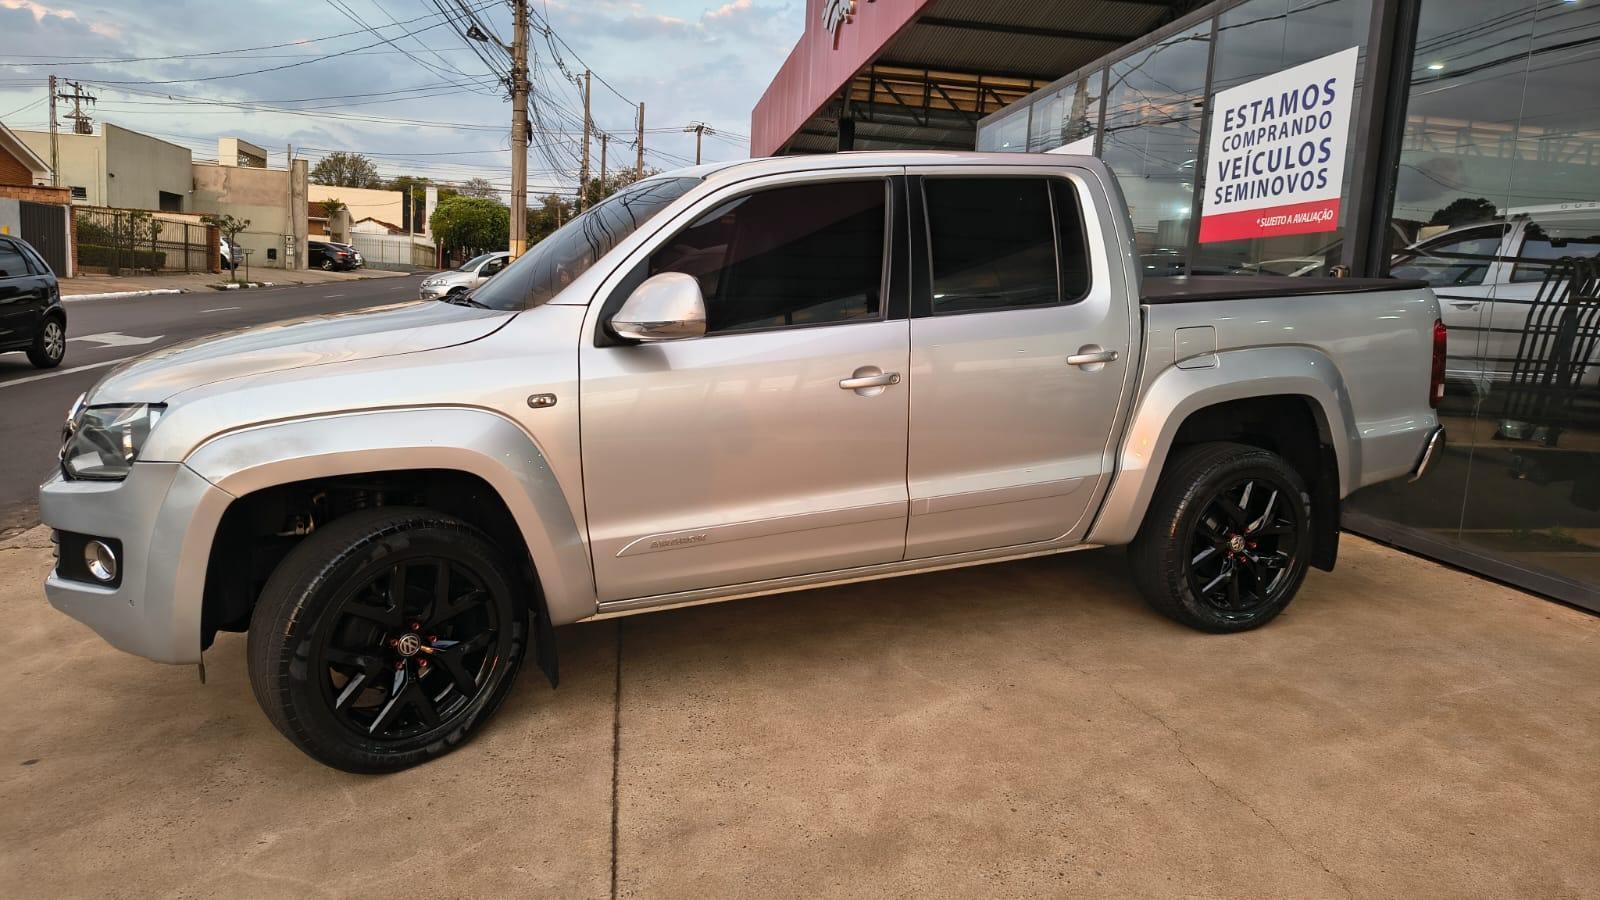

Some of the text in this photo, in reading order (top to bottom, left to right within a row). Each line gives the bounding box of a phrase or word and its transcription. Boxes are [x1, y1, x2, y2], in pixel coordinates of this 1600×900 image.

[1224, 78, 1337, 132] ESTAMOS
[1222, 111, 1332, 153] COMPRANDO
[1219, 137, 1332, 182] VEÍCULOS
[1214, 168, 1328, 205] SEMINOVOS
[1293, 209, 1333, 223] AVALIAÇÃO
